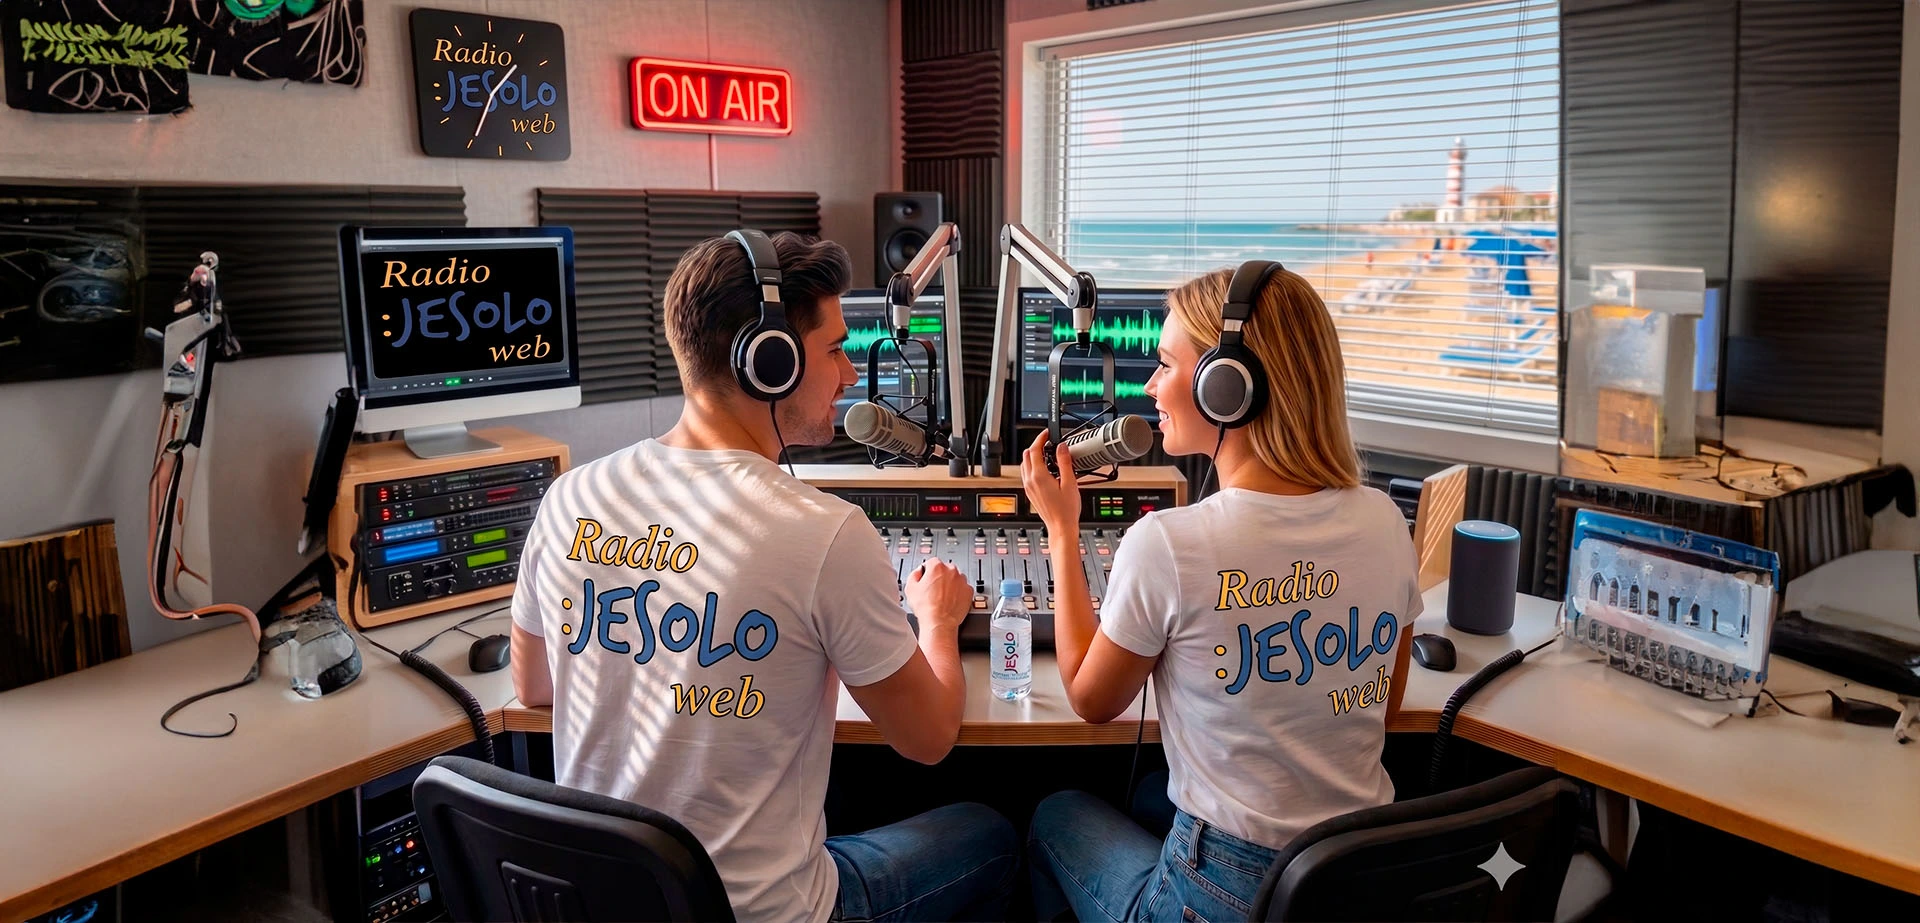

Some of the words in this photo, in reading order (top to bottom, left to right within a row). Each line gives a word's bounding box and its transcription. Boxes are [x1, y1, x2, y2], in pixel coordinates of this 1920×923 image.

[433, 38, 512, 66] Radio
[650, 73, 708, 118] ON
[723, 79, 781, 123] AIR
[511, 113, 556, 134] web
[380, 257, 491, 288] Radio
[488, 335, 551, 362] web
[566, 517, 699, 573] Radio
[1214, 560, 1339, 611] Radio
[670, 675, 765, 719] web
[1328, 664, 1391, 717] web
